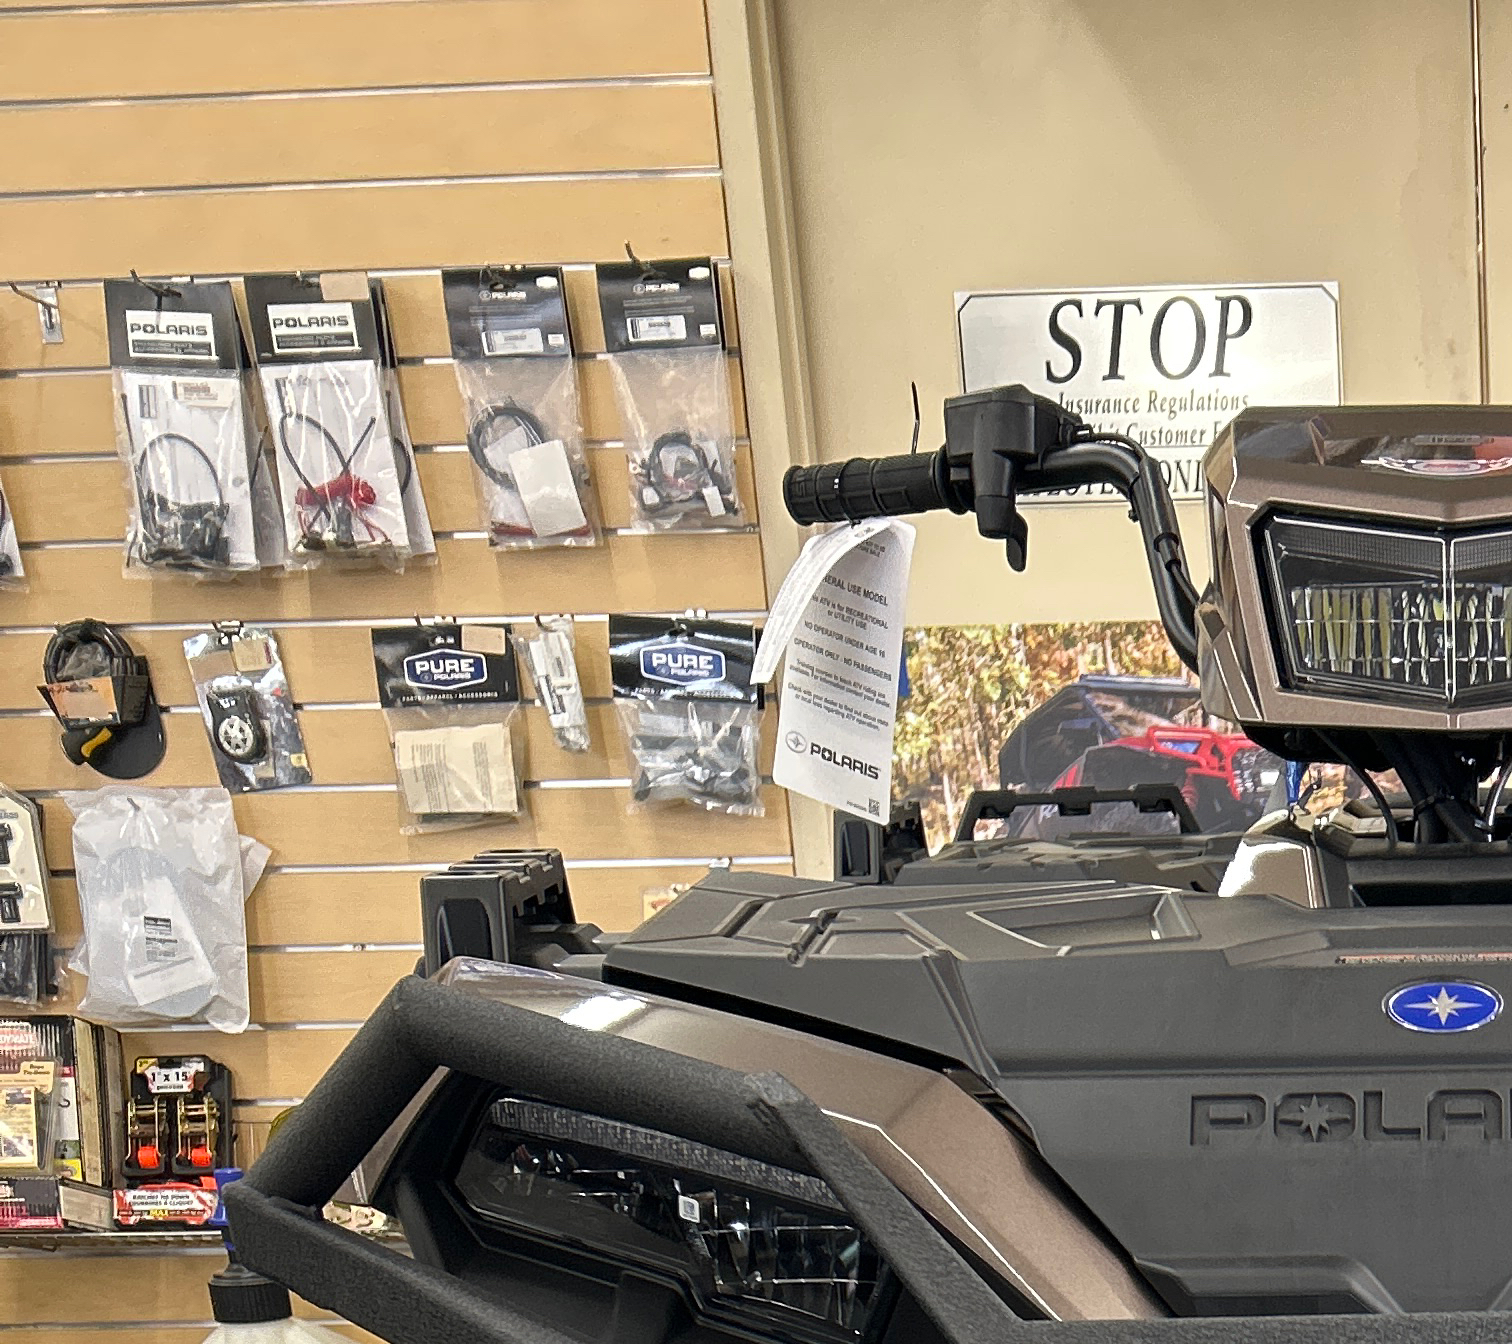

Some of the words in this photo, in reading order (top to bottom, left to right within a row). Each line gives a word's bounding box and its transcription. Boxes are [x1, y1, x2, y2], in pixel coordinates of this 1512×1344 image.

[130, 323, 207, 336] POLARIS
[272, 315, 349, 329] POLARIS
[1045, 295, 1253, 384] STOP
[1058, 391, 1141, 415] Insurance
[1146, 388, 1250, 420] Regulations
[415, 659, 475, 675] PURE
[652, 653, 713, 669] PURE
[810, 742, 879, 780] POLARIS
